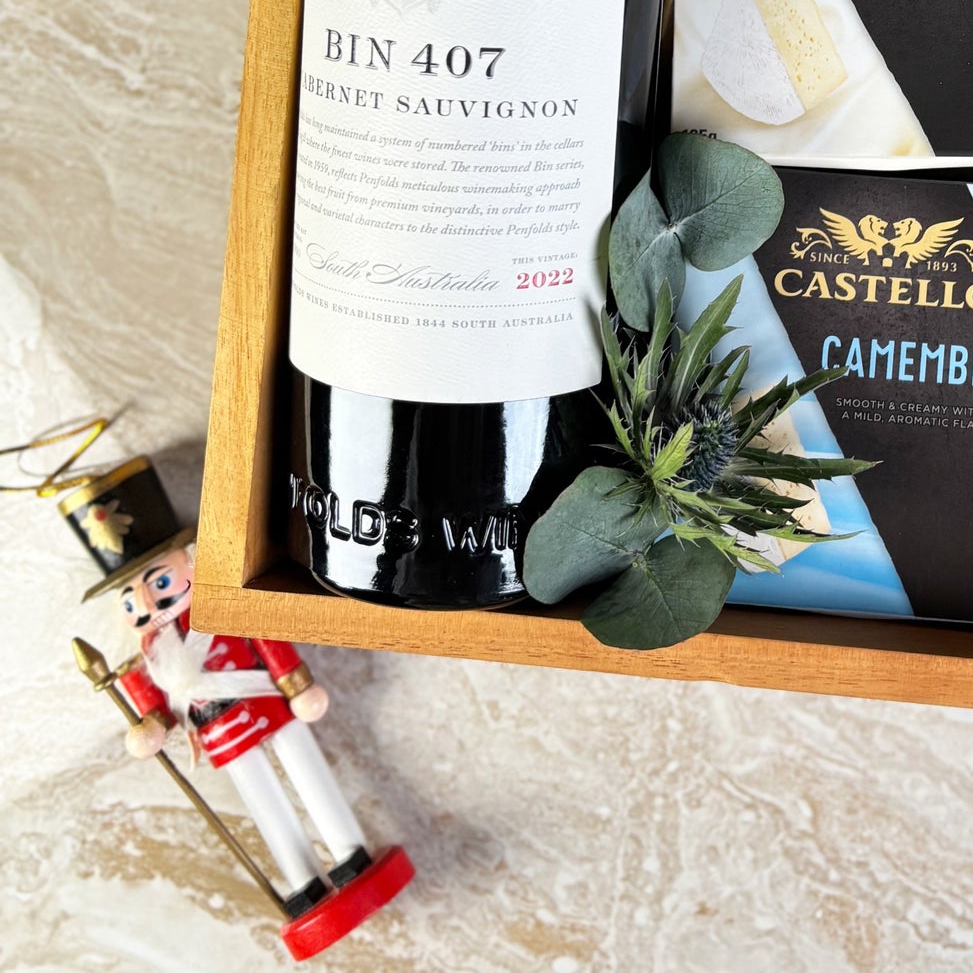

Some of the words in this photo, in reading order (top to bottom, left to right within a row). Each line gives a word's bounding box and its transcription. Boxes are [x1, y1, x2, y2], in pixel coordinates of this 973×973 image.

[324, 28, 397, 72] BIN
[411, 43, 506, 79] 407
[303, 72, 384, 110] ABERNET
[396, 94, 579, 119] SAUVIGNON
[324, 124, 370, 142] maintained
[370, 134, 378, 143] a
[378, 135, 412, 148] system
[414, 137, 430, 152] of
[428, 140, 487, 152] numbered
[520, 141, 533, 152] in
[534, 140, 552, 151] the
[553, 138, 585, 151] cellars
[353, 152, 382, 165] wines
[383, 158, 410, 169] were
[411, 160, 447, 172] stored.
[450, 160, 471, 173] The
[472, 160, 531, 173] renowned
[533, 160, 553, 172] Bin
[554, 157, 585, 171] series,
[360, 171, 400, 189] Penfolds
[401, 181, 460, 194] meticulous
[462, 182, 533, 197] winemaking
[535, 178, 582, 197] approach
[344, 190, 369, 205] from
[369, 197, 419, 212] premium
[421, 202, 483, 217] vineyards,
[486, 204, 500, 215] in
[502, 203, 532, 215] order
[535, 202, 546, 213] to
[548, 201, 582, 214] marry
[354, 214, 404, 232] characters
[406, 223, 418, 233] to
[420, 222, 439, 235] the
[440, 223, 504, 236] distinctive
[506, 222, 553, 238] Penfolds
[554, 219, 581, 235] style.
[306, 242, 370, 279] South
[366, 264, 500, 292] Australia
[512, 256, 535, 265] THIS
[809, 252, 850, 265] SINCE
[926, 260, 958, 272] 1893
[516, 267, 575, 290] 2022
[332, 303, 410, 326] ESTABLISHED
[415, 317, 446, 328] 1844
[451, 320, 497, 329] SOUTH
[502, 312, 574, 328] AUSTRALIA
[836, 398, 885, 409] SMOOTH
[888, 402, 896, 410] &
[900, 403, 948, 414] CREAMY
[842, 411, 850, 420] A
[854, 412, 884, 423] MILD,
[888, 415, 949, 427] AROMATIC
